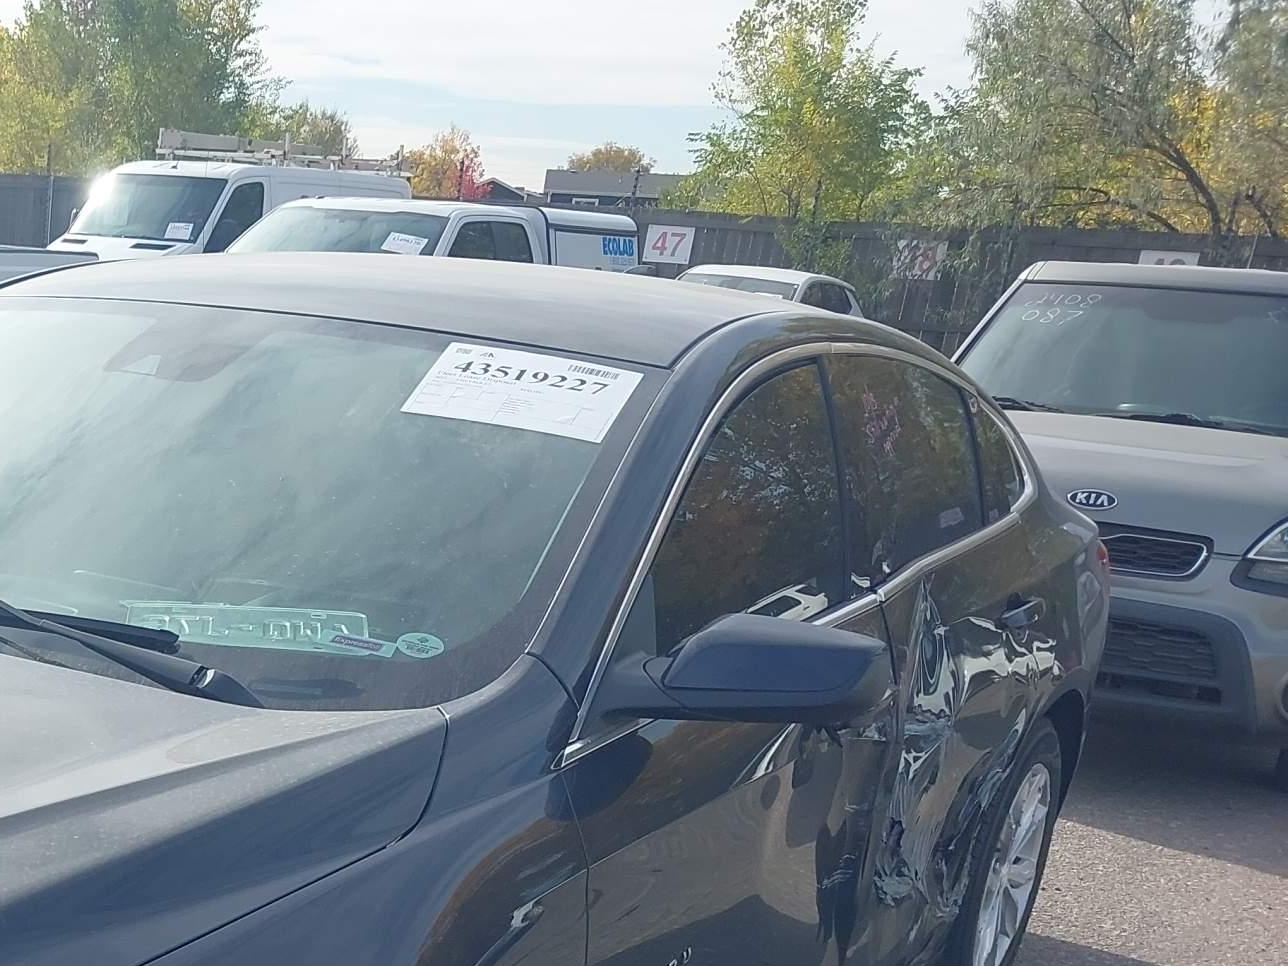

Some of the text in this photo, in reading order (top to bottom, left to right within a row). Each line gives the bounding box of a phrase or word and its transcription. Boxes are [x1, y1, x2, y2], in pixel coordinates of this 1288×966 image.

[601, 236, 634, 256] ECOLAB
[651, 231, 687, 257] 47
[1021, 307, 1084, 326] 087
[453, 359, 613, 396] 43519227
[1075, 492, 1109, 506] KIA
